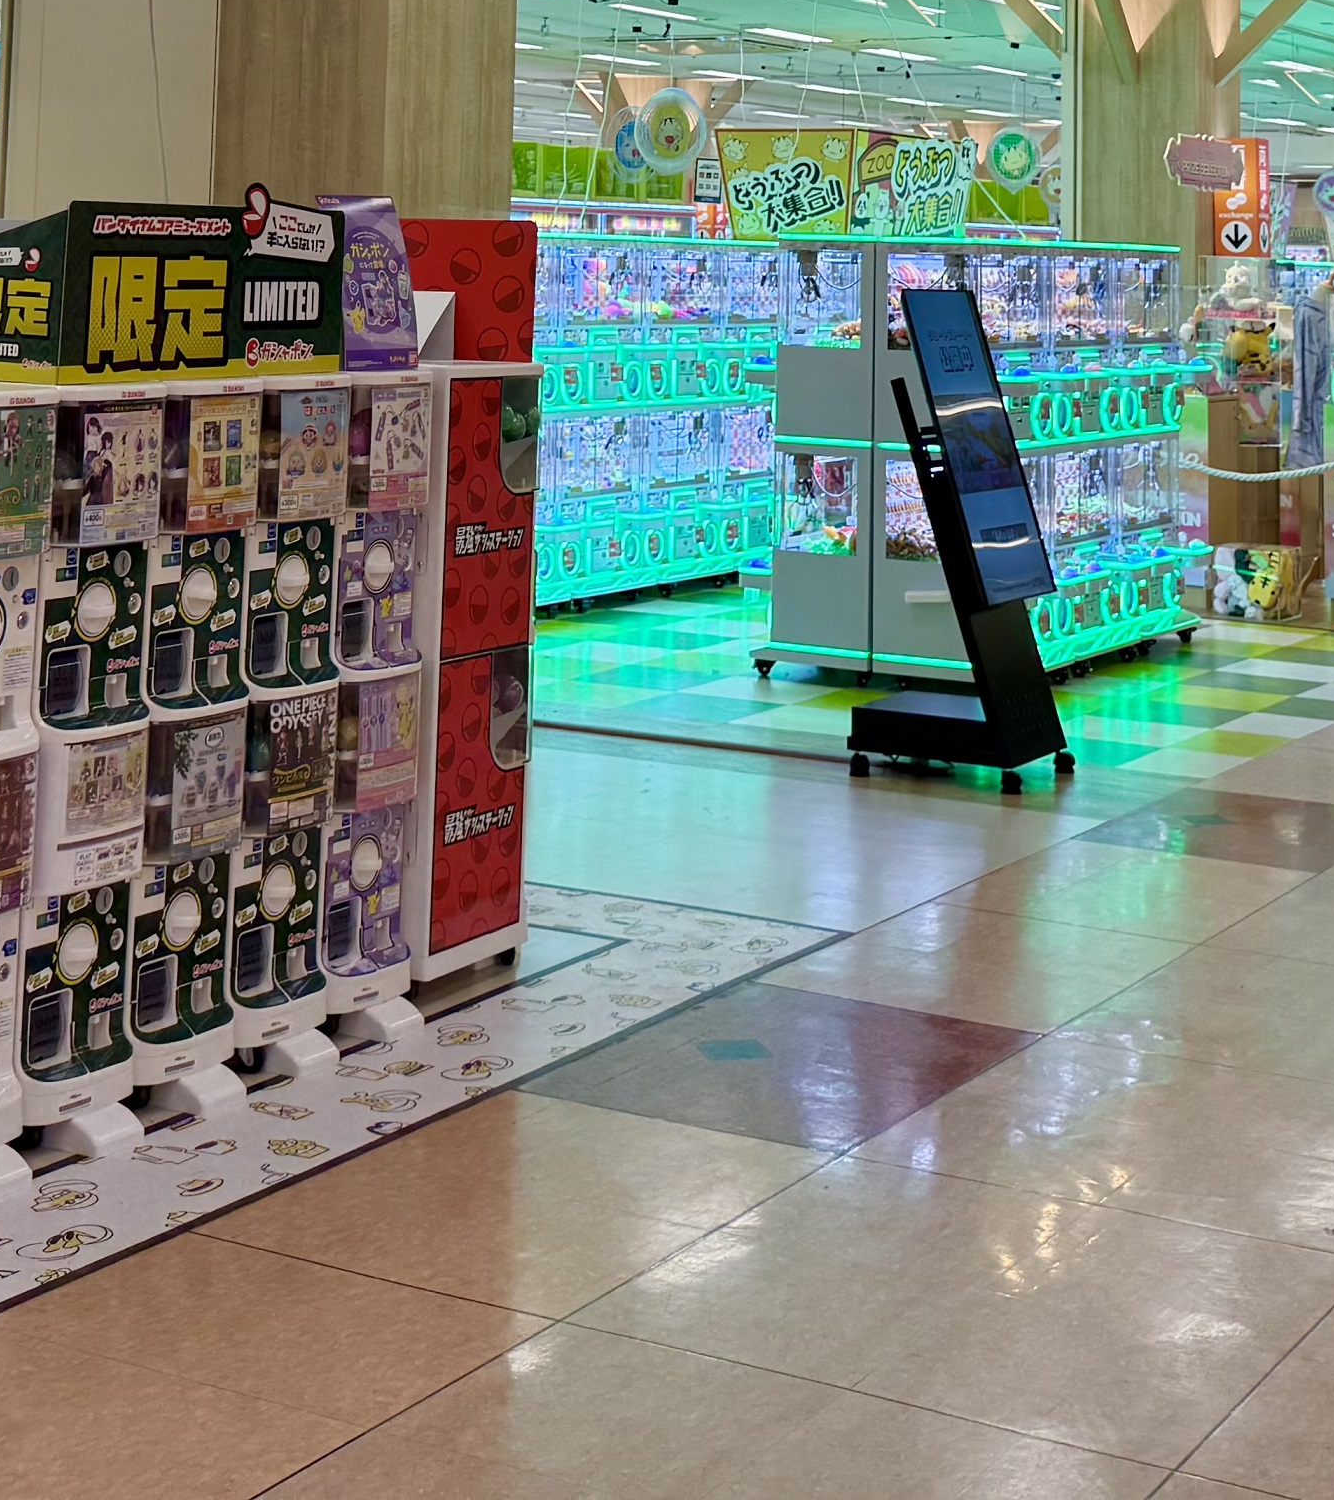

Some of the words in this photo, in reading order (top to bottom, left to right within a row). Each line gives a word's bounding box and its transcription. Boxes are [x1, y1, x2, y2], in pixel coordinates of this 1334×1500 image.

[866, 153, 893, 174] ZOO
[896, 148, 955, 192] どうぶつ
[732, 161, 821, 210] どうぶつ
[763, 177, 845, 231] 大集合!!
[1218, 212, 1254, 220] exchange
[93, 215, 232, 237] バンダイナムコアミューズメント
[350, 242, 390, 259] ガシャポン
[87, 255, 229, 364] 限定
[243, 281, 320, 323] LIMITED
[260, 339, 314, 362] ガシャポン
[270, 698, 301, 718] ONE
[301, 693, 327, 713] PIECE
[270, 709, 324, 734] ODYSSEY
